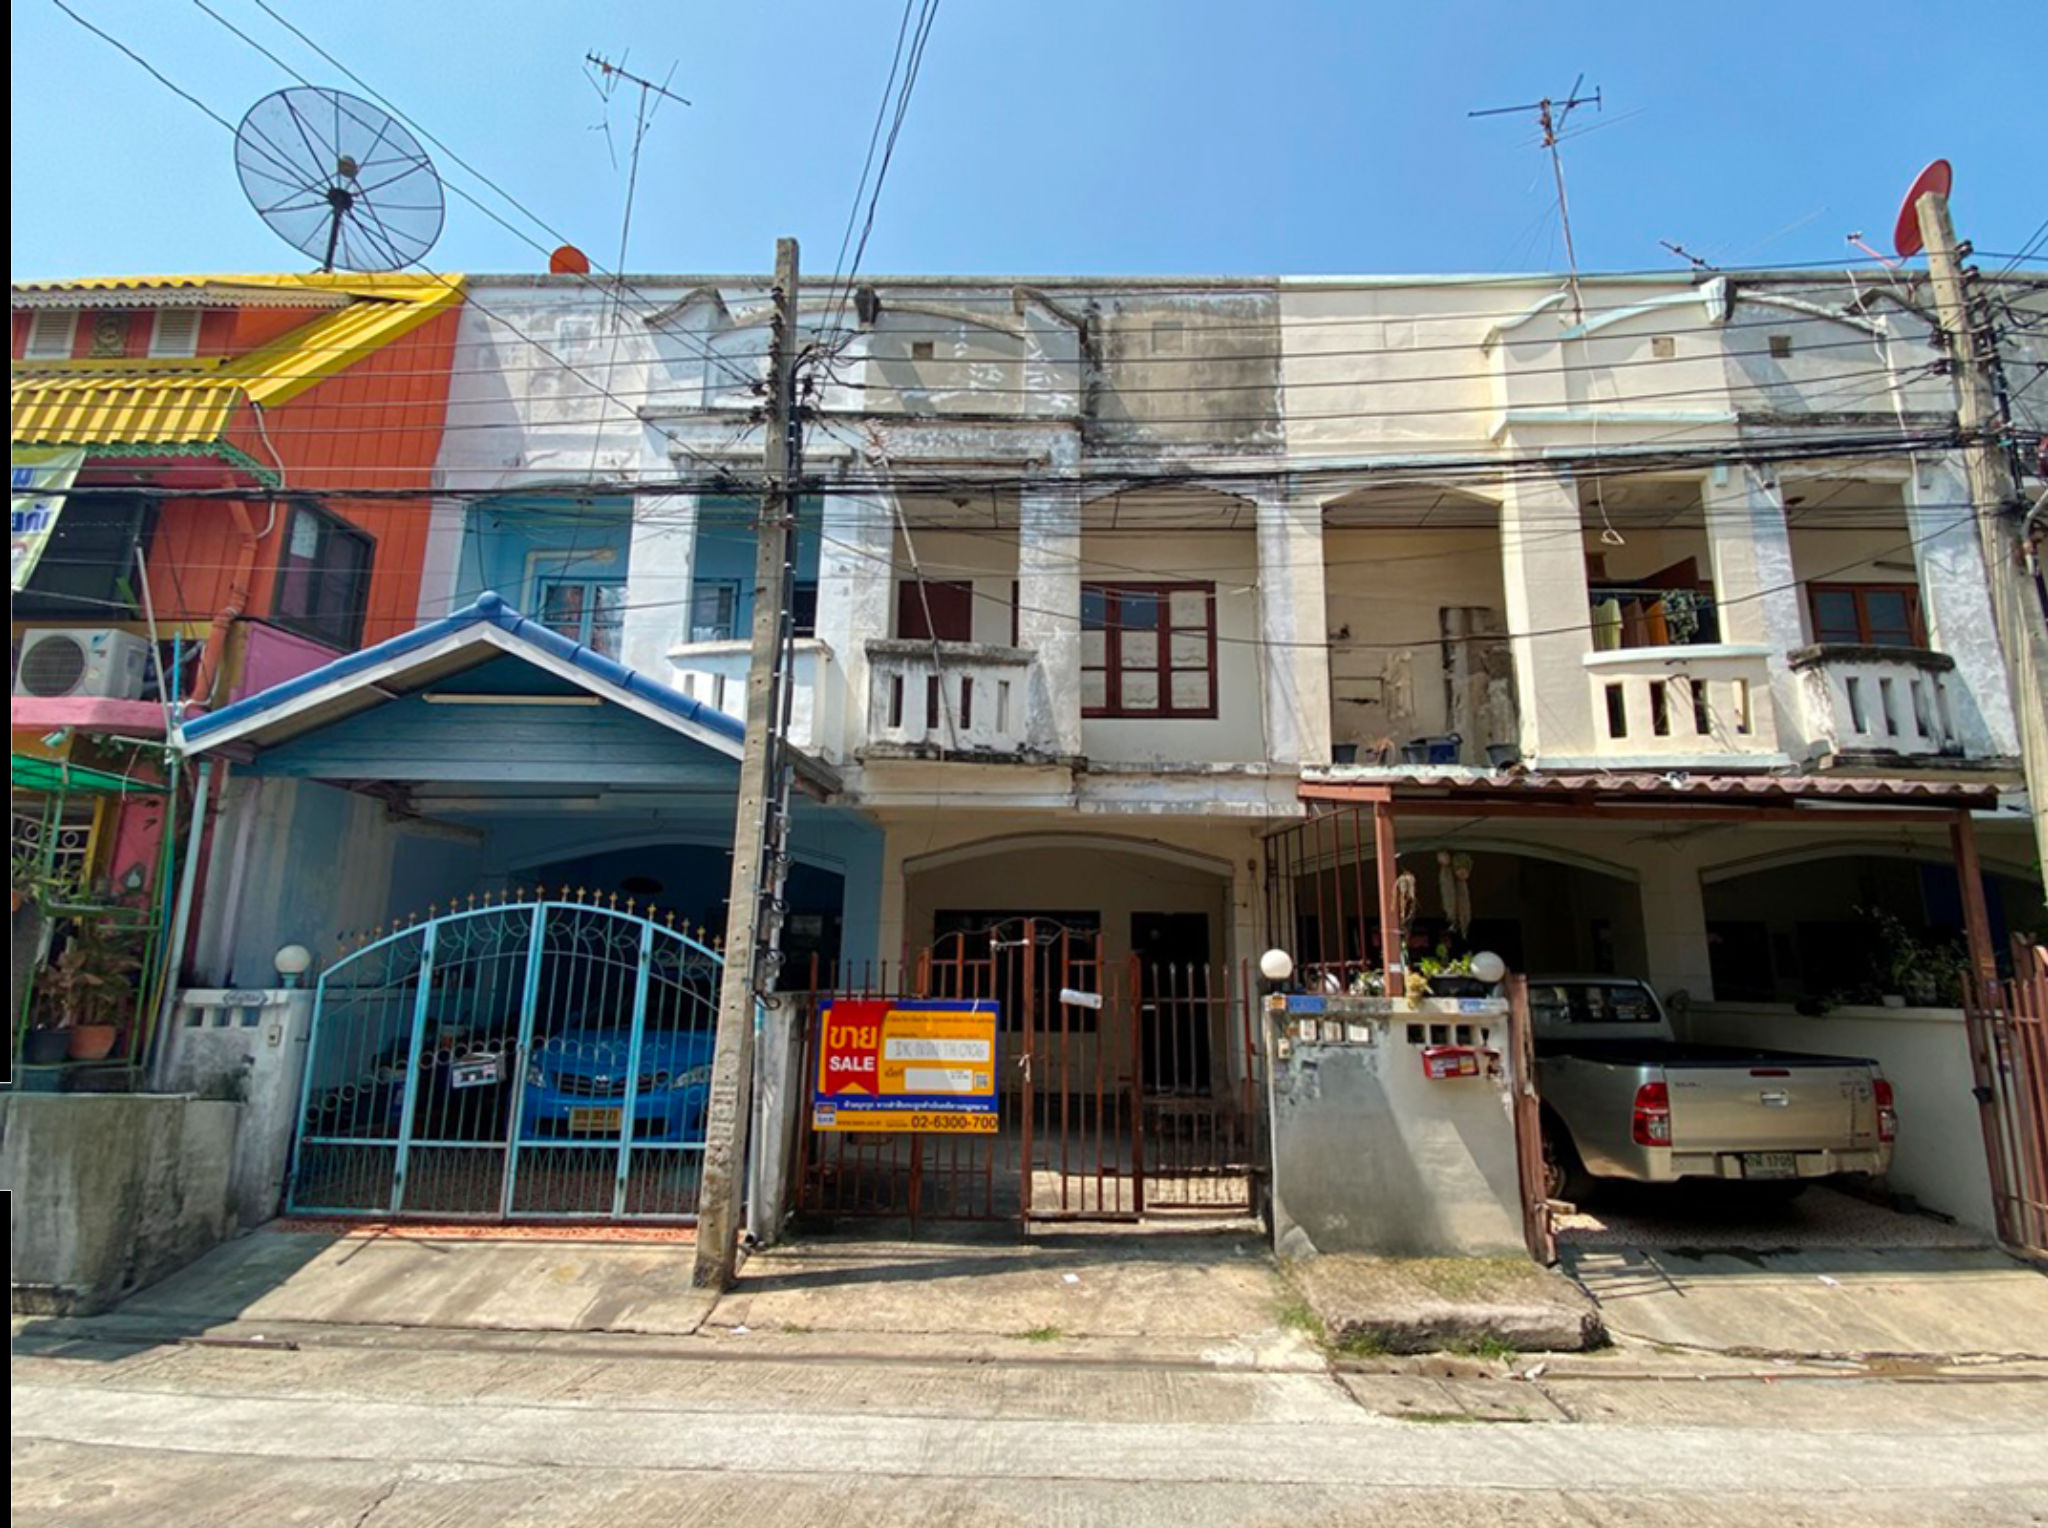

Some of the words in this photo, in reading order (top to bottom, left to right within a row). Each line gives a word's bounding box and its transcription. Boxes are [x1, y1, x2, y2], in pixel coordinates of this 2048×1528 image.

[830, 1025, 877, 1049] ขาย
[829, 1056, 875, 1071] SALE
[911, 1115, 997, 1130] 02-6300-700
